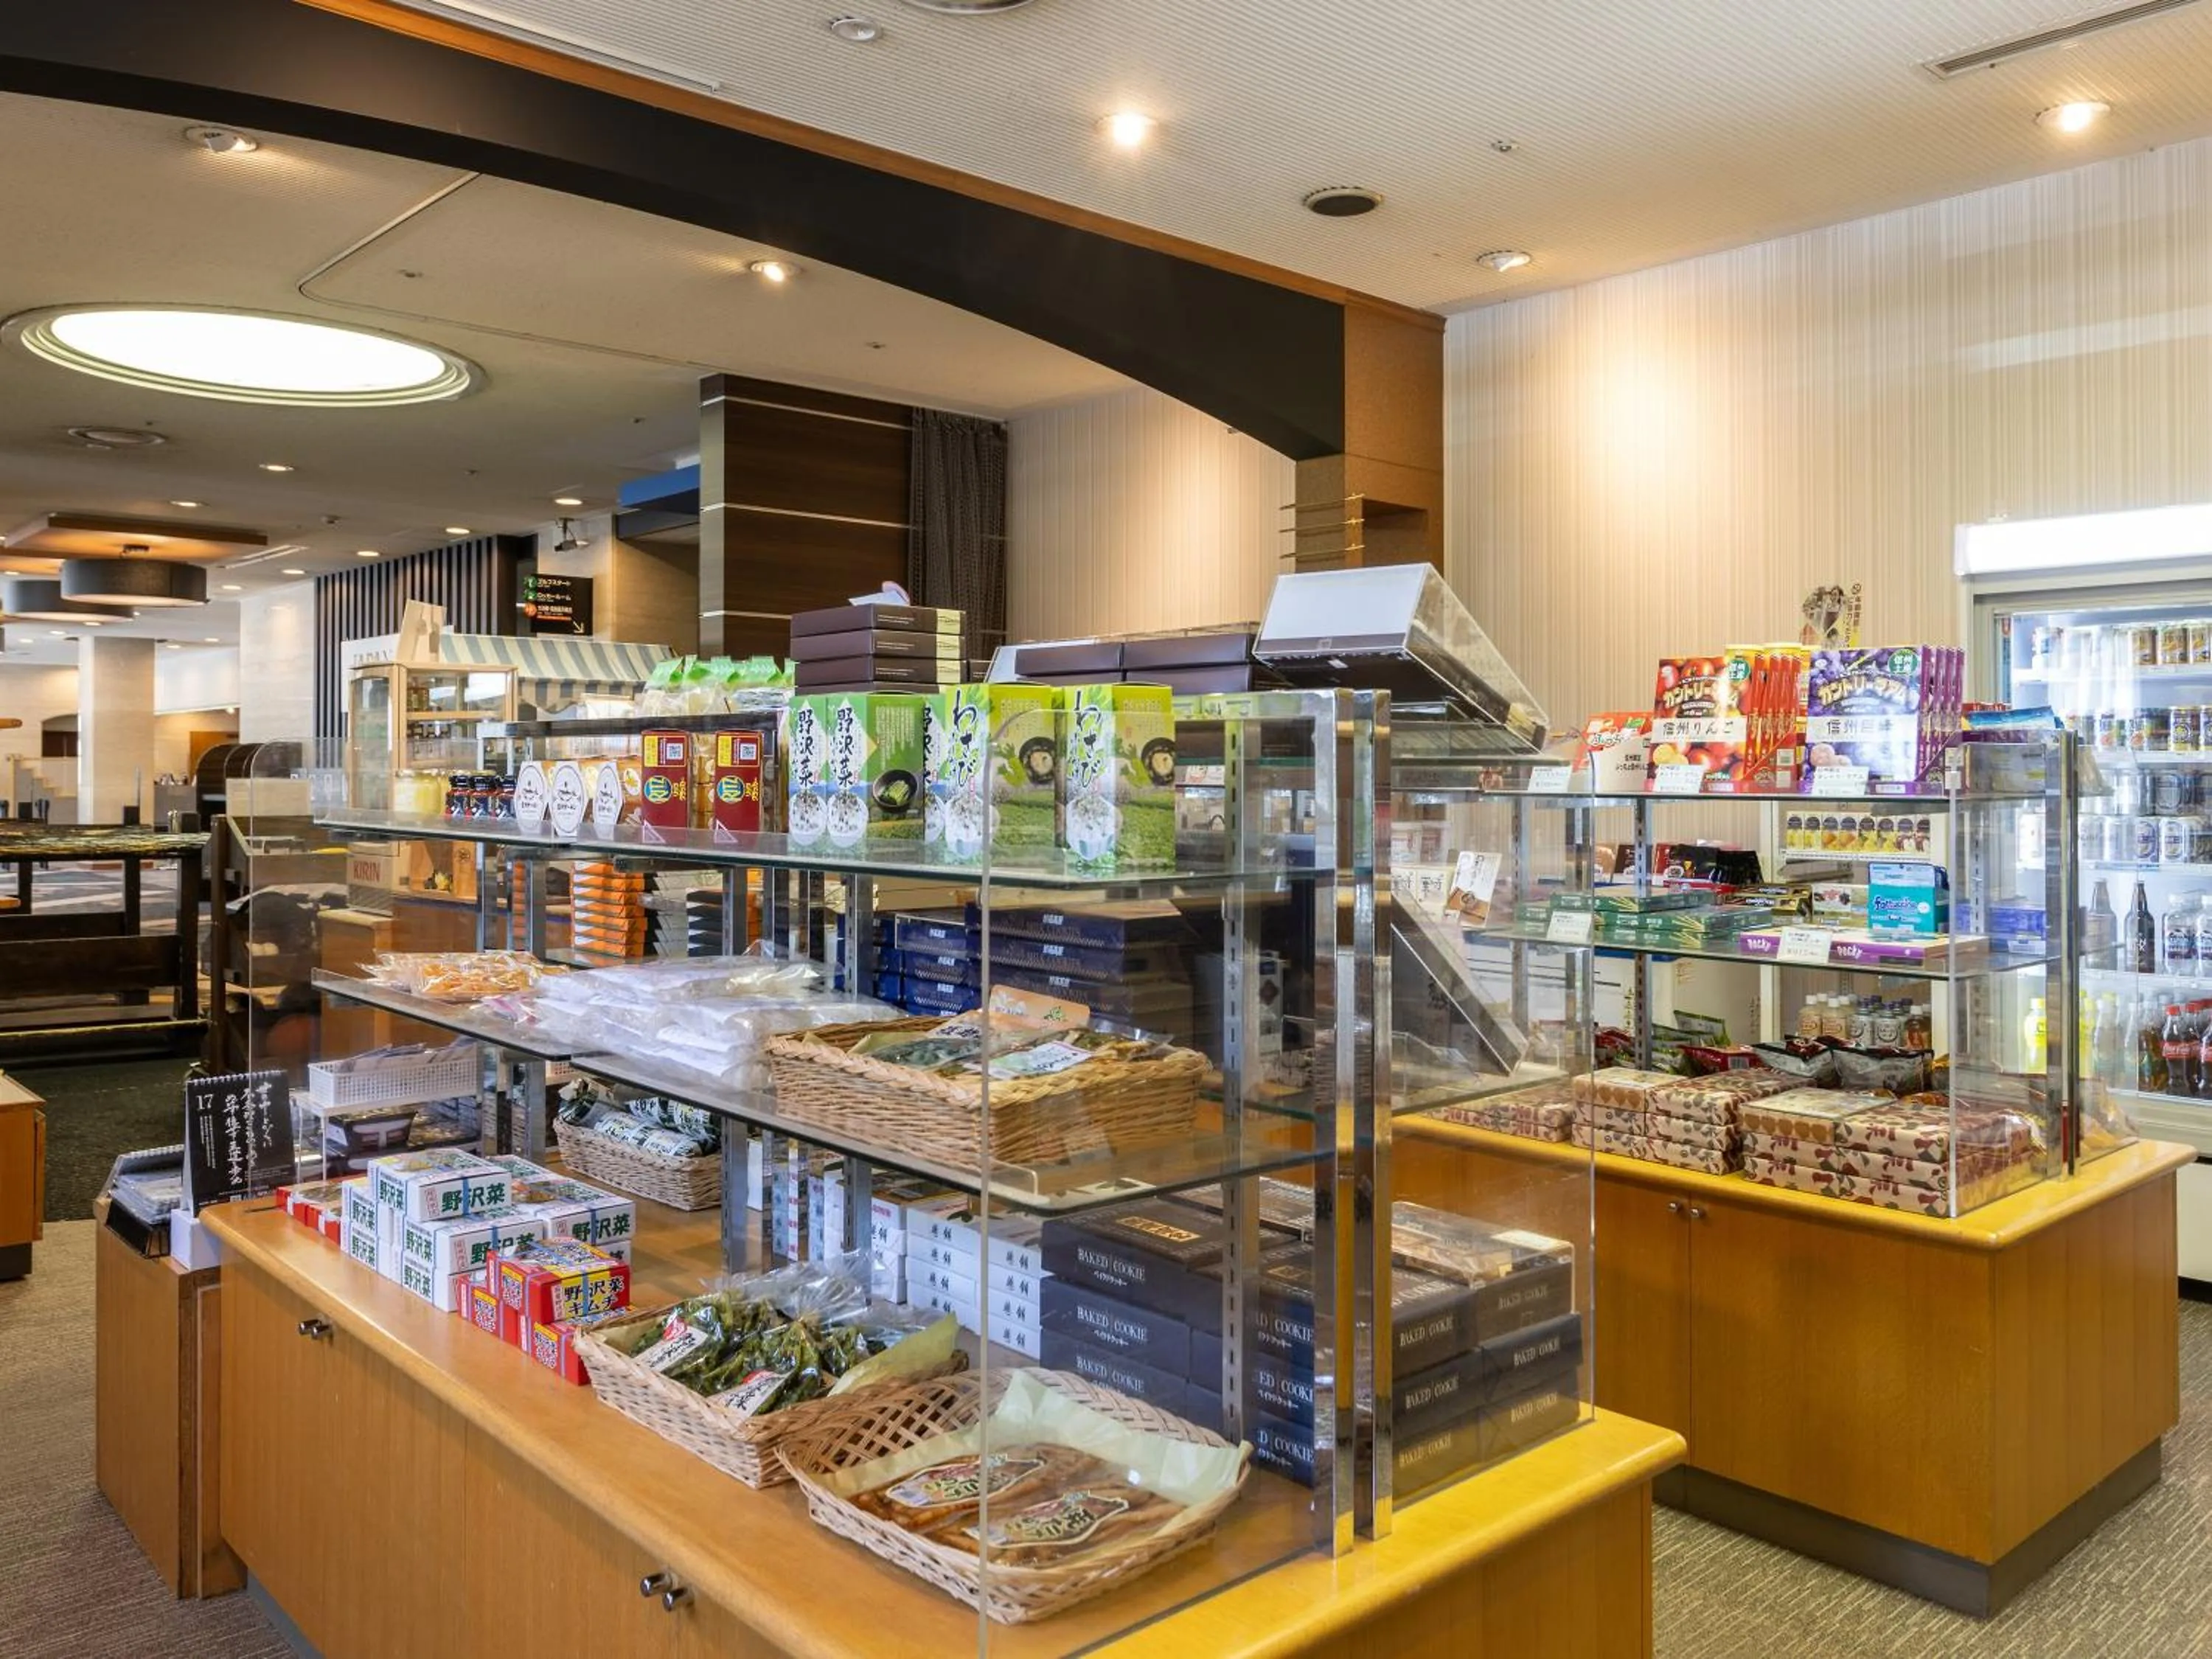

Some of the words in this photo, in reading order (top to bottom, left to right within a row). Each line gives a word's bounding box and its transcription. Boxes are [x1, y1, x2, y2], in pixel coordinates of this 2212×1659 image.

[1664, 682, 1739, 708] カントリーム
[1818, 674, 1906, 706] カントリーマアム
[953, 690, 978, 787] わさび
[1074, 690, 1102, 788] わさび
[1663, 721, 1733, 736] 信州りんご
[799, 709, 813, 787] 野沢菜
[838, 708, 853, 787] 野沢菜
[644, 776, 671, 802] RITZ
[717, 776, 744, 802] RITZ
[354, 860, 380, 883] KIRIN
[196, 1093, 214, 1110] 17
[379, 1178, 405, 1211] 野沢菜
[442, 1181, 506, 1213] 野沢菜
[352, 1199, 375, 1231] 野沢菜
[572, 1214, 630, 1242] 野沢菜
[352, 1234, 375, 1266] 野沢菜
[406, 1227, 433, 1262] 野沢菜
[1077, 1248, 1108, 1267] BAKED
[1113, 1259, 1145, 1281] COOKIE
[404, 1263, 431, 1299] 野沢菜
[563, 1275, 626, 1301] 野沢菜
[568, 1293, 617, 1317] キムチ
[1077, 1306, 1108, 1326] BAKED
[1114, 1321, 1147, 1342] COOKIE
[1400, 1327, 1426, 1347] BAKED
[1513, 1347, 1536, 1366] BAKED
[1077, 1356, 1107, 1376] BAKED
[1112, 1369, 1144, 1393] COOKIE
[1281, 1380, 1313, 1403] COOKI
[1405, 1389, 1432, 1409] BAKED
